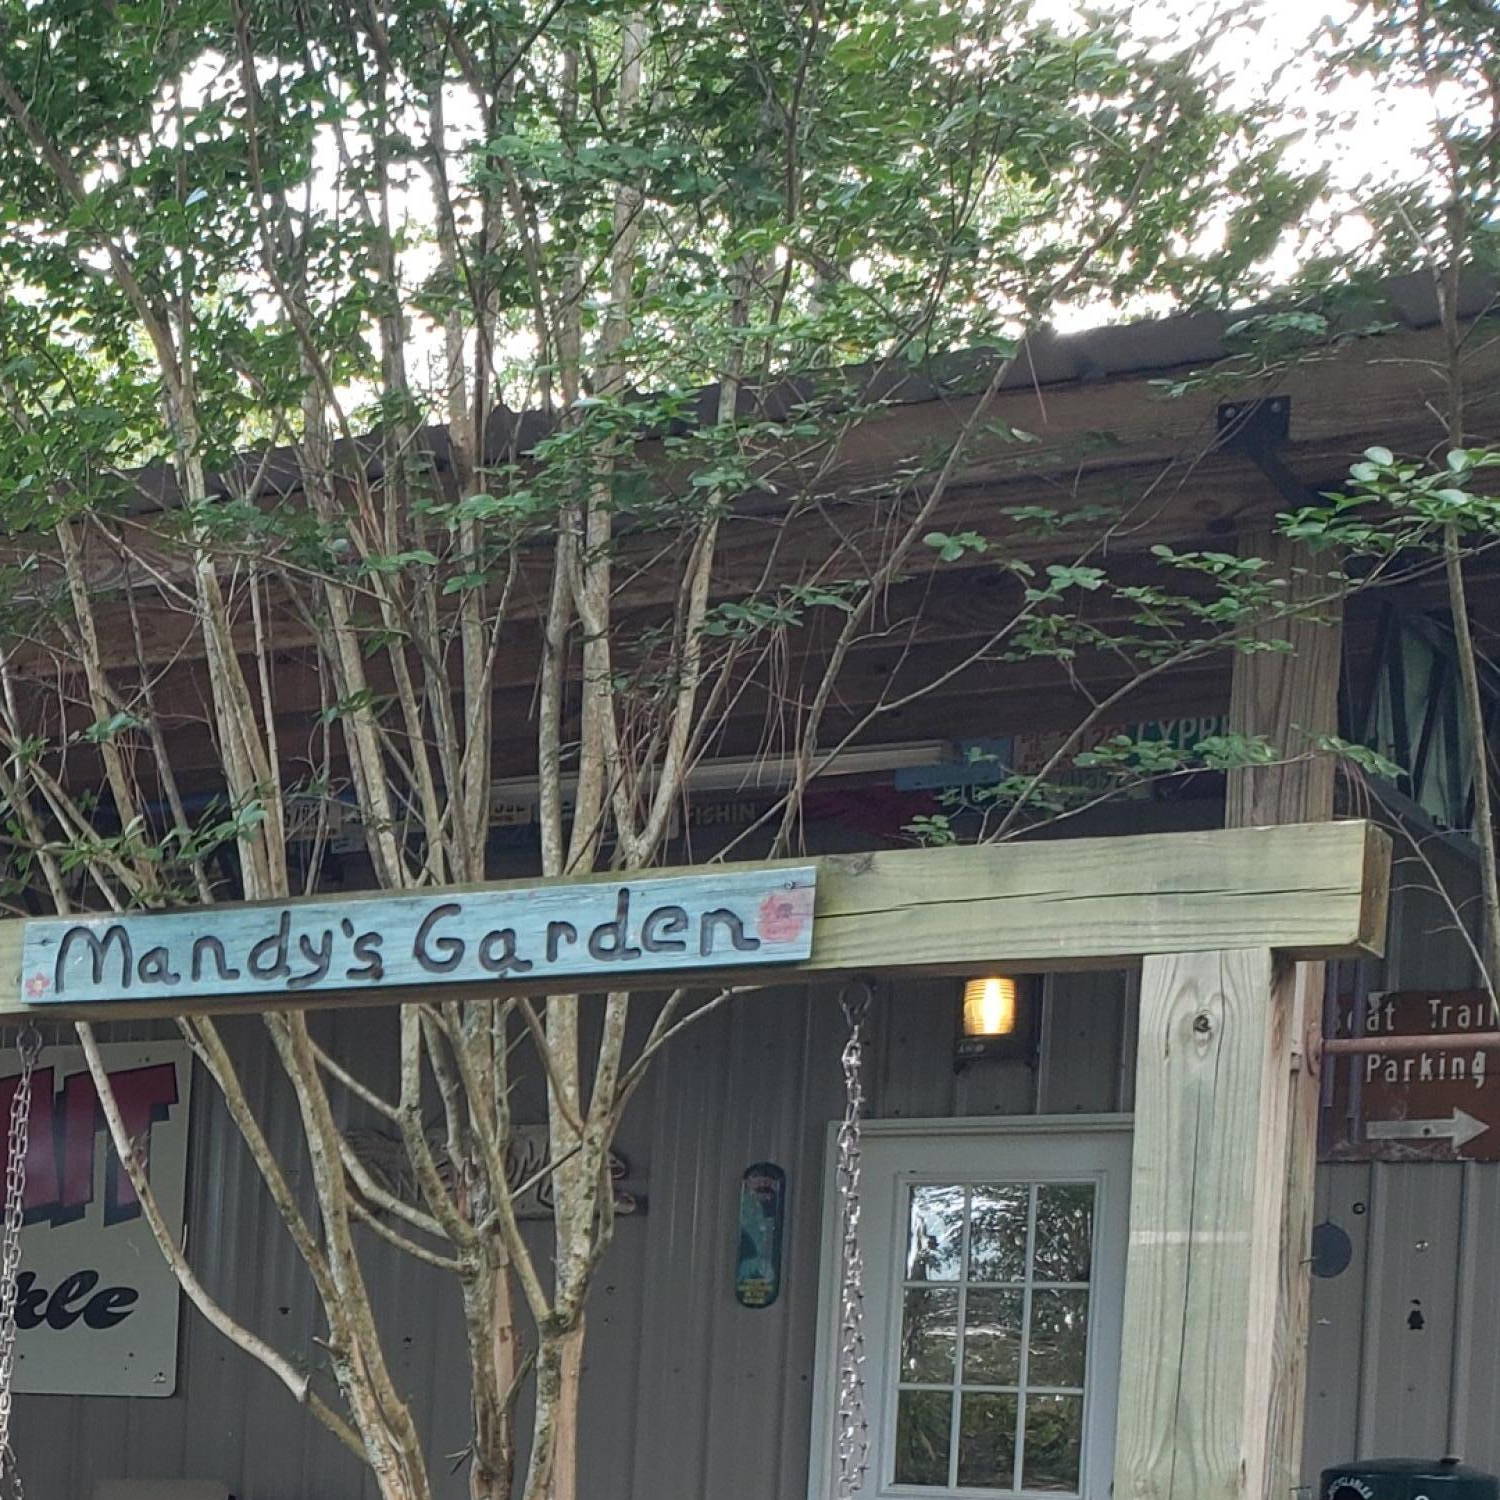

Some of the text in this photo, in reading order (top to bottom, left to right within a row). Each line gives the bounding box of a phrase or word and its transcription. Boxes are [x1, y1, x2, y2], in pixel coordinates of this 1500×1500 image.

[55, 887, 761, 994] Mandy's Garden
[1366, 1051, 1486, 1089] Parking
